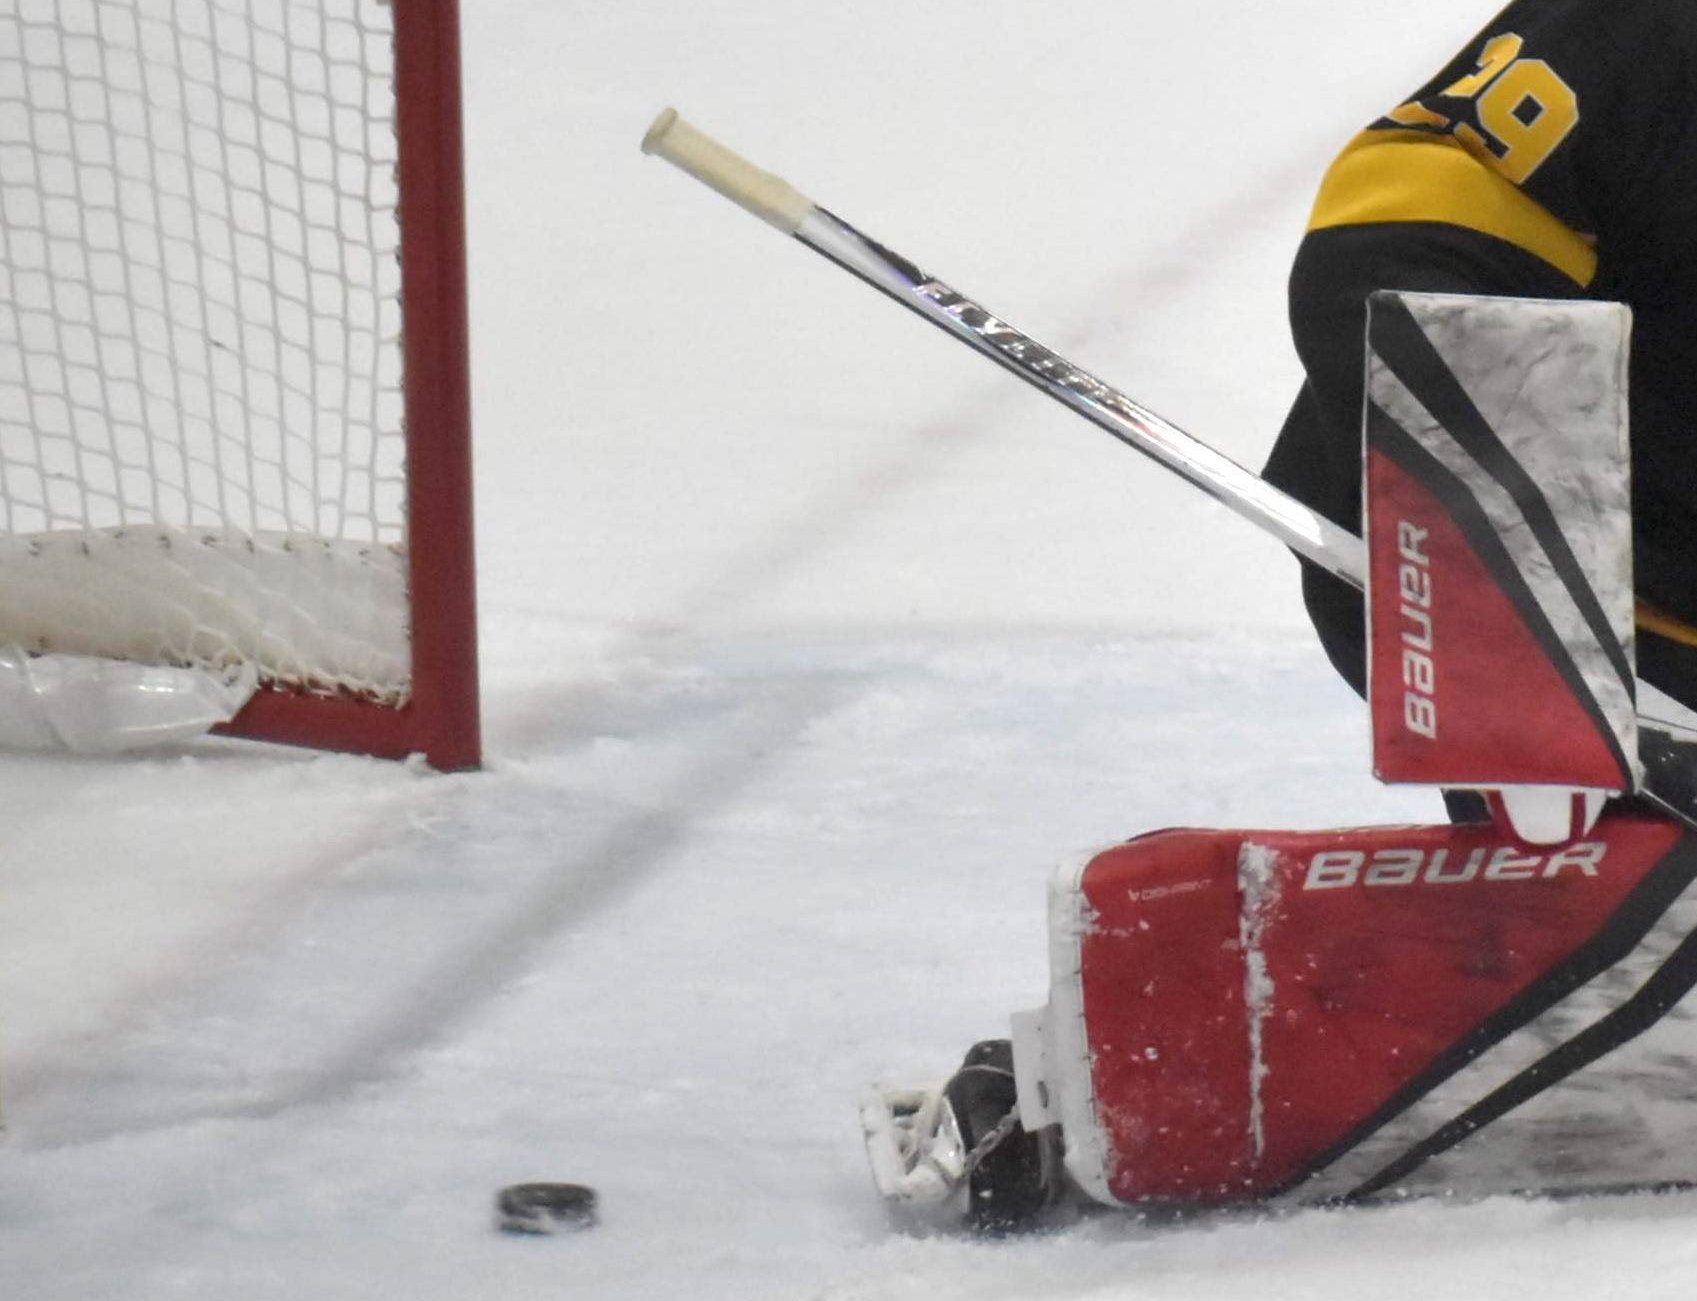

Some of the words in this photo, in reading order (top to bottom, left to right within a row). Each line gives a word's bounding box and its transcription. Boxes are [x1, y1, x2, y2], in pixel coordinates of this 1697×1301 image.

[1384, 32, 1580, 185] 29
[1398, 520, 1437, 740] BAUER
[1302, 841, 1607, 891] BAUER
